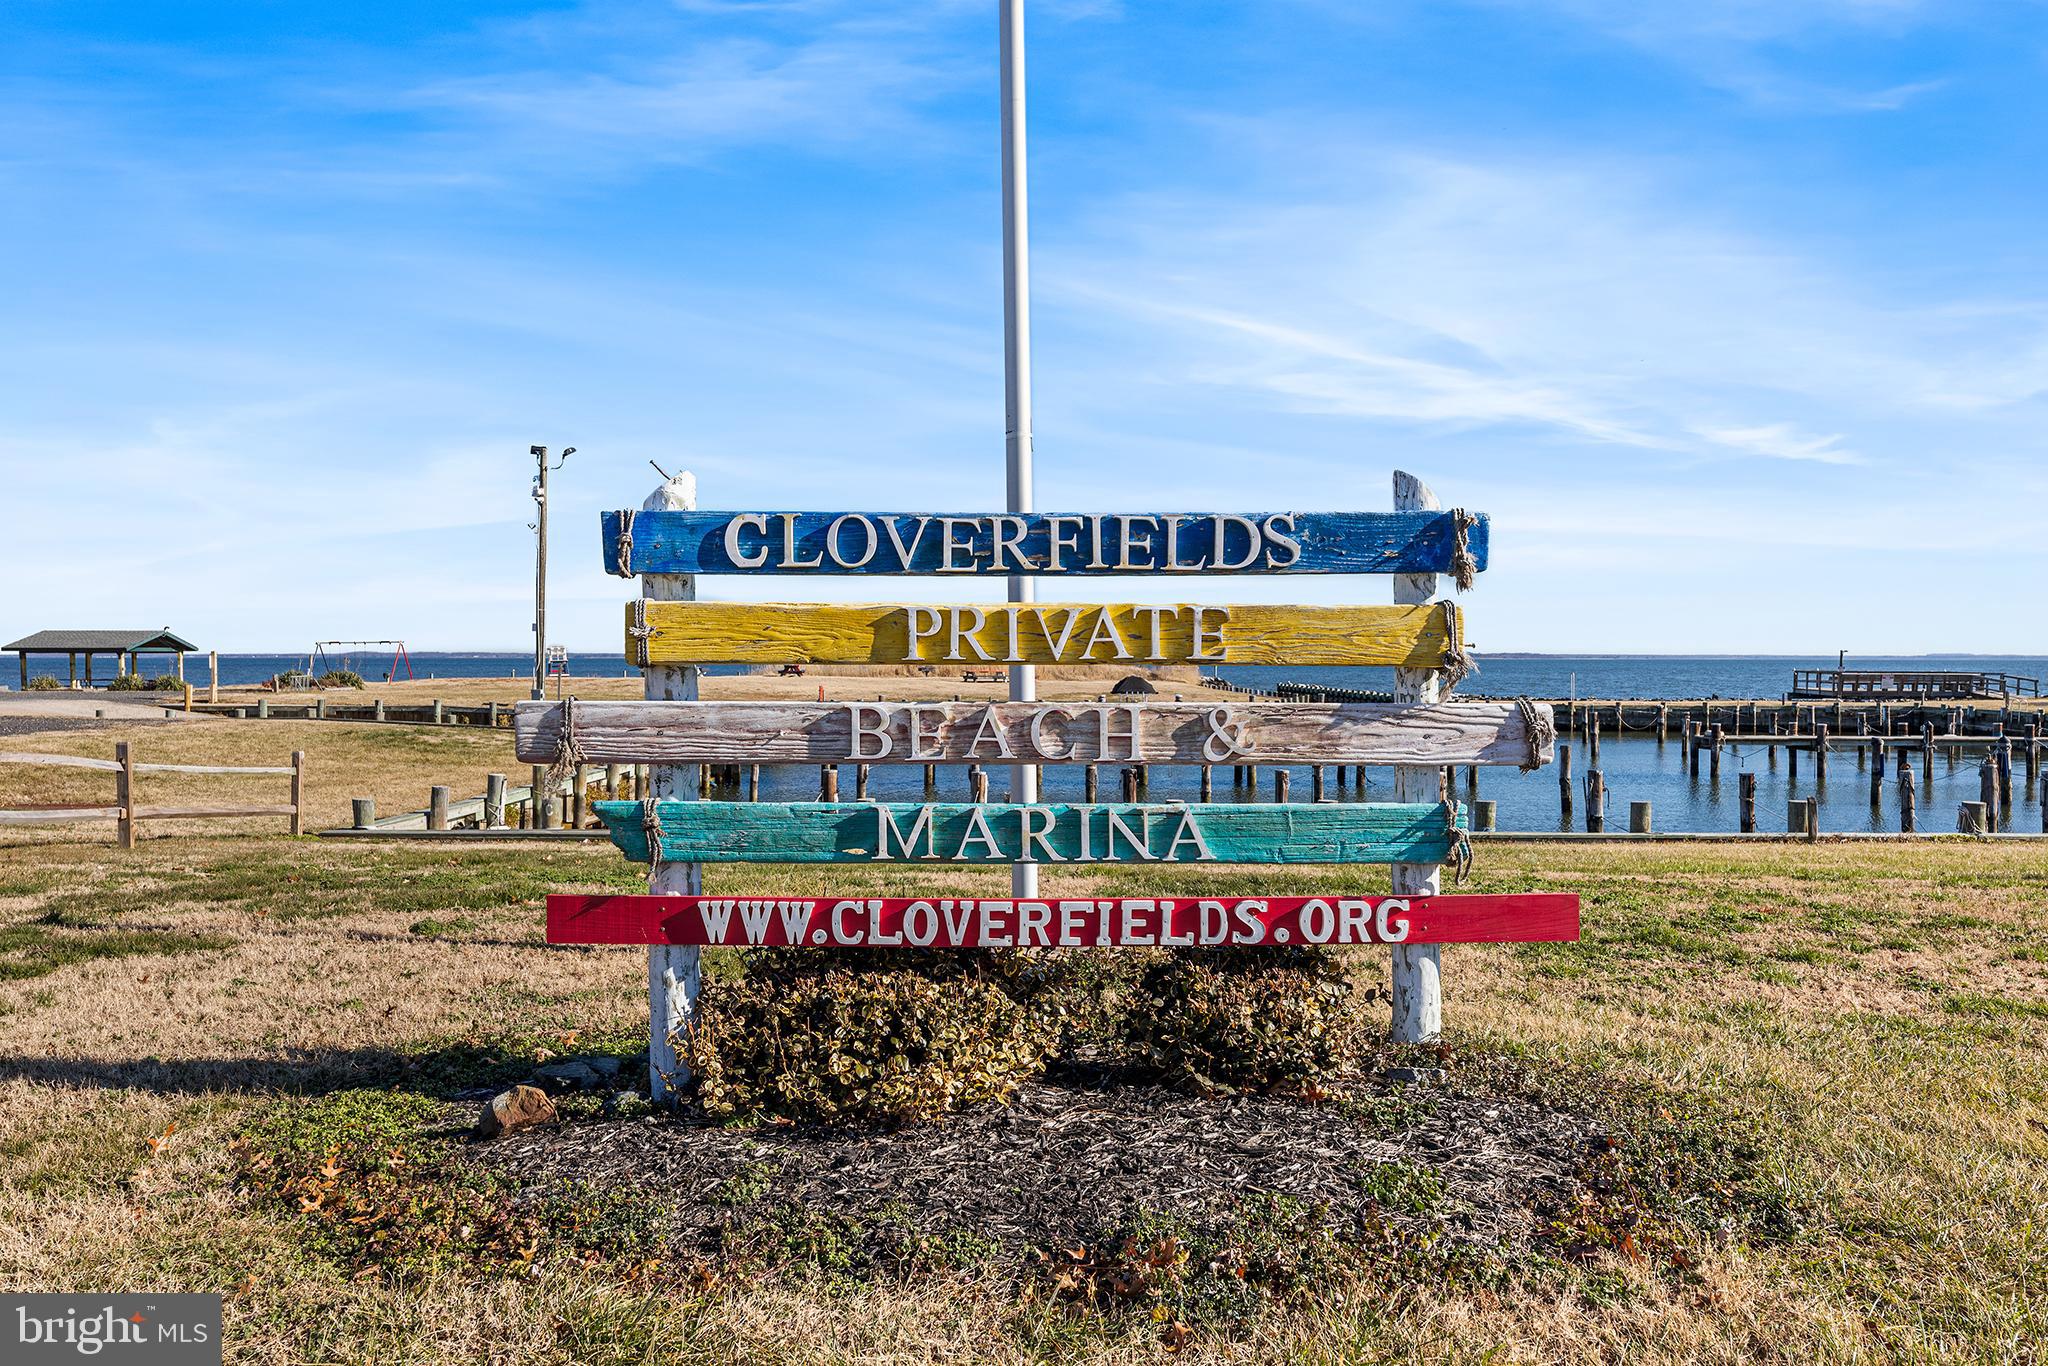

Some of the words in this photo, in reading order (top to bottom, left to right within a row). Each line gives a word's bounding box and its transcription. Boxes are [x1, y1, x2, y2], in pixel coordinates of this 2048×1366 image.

[725, 512, 1301, 571] CLOVERFIELDS
[904, 606, 1230, 661] PRIVATE
[847, 705, 1143, 761] BEACH
[1202, 707, 1256, 763] &
[874, 807, 1215, 861] MARINA
